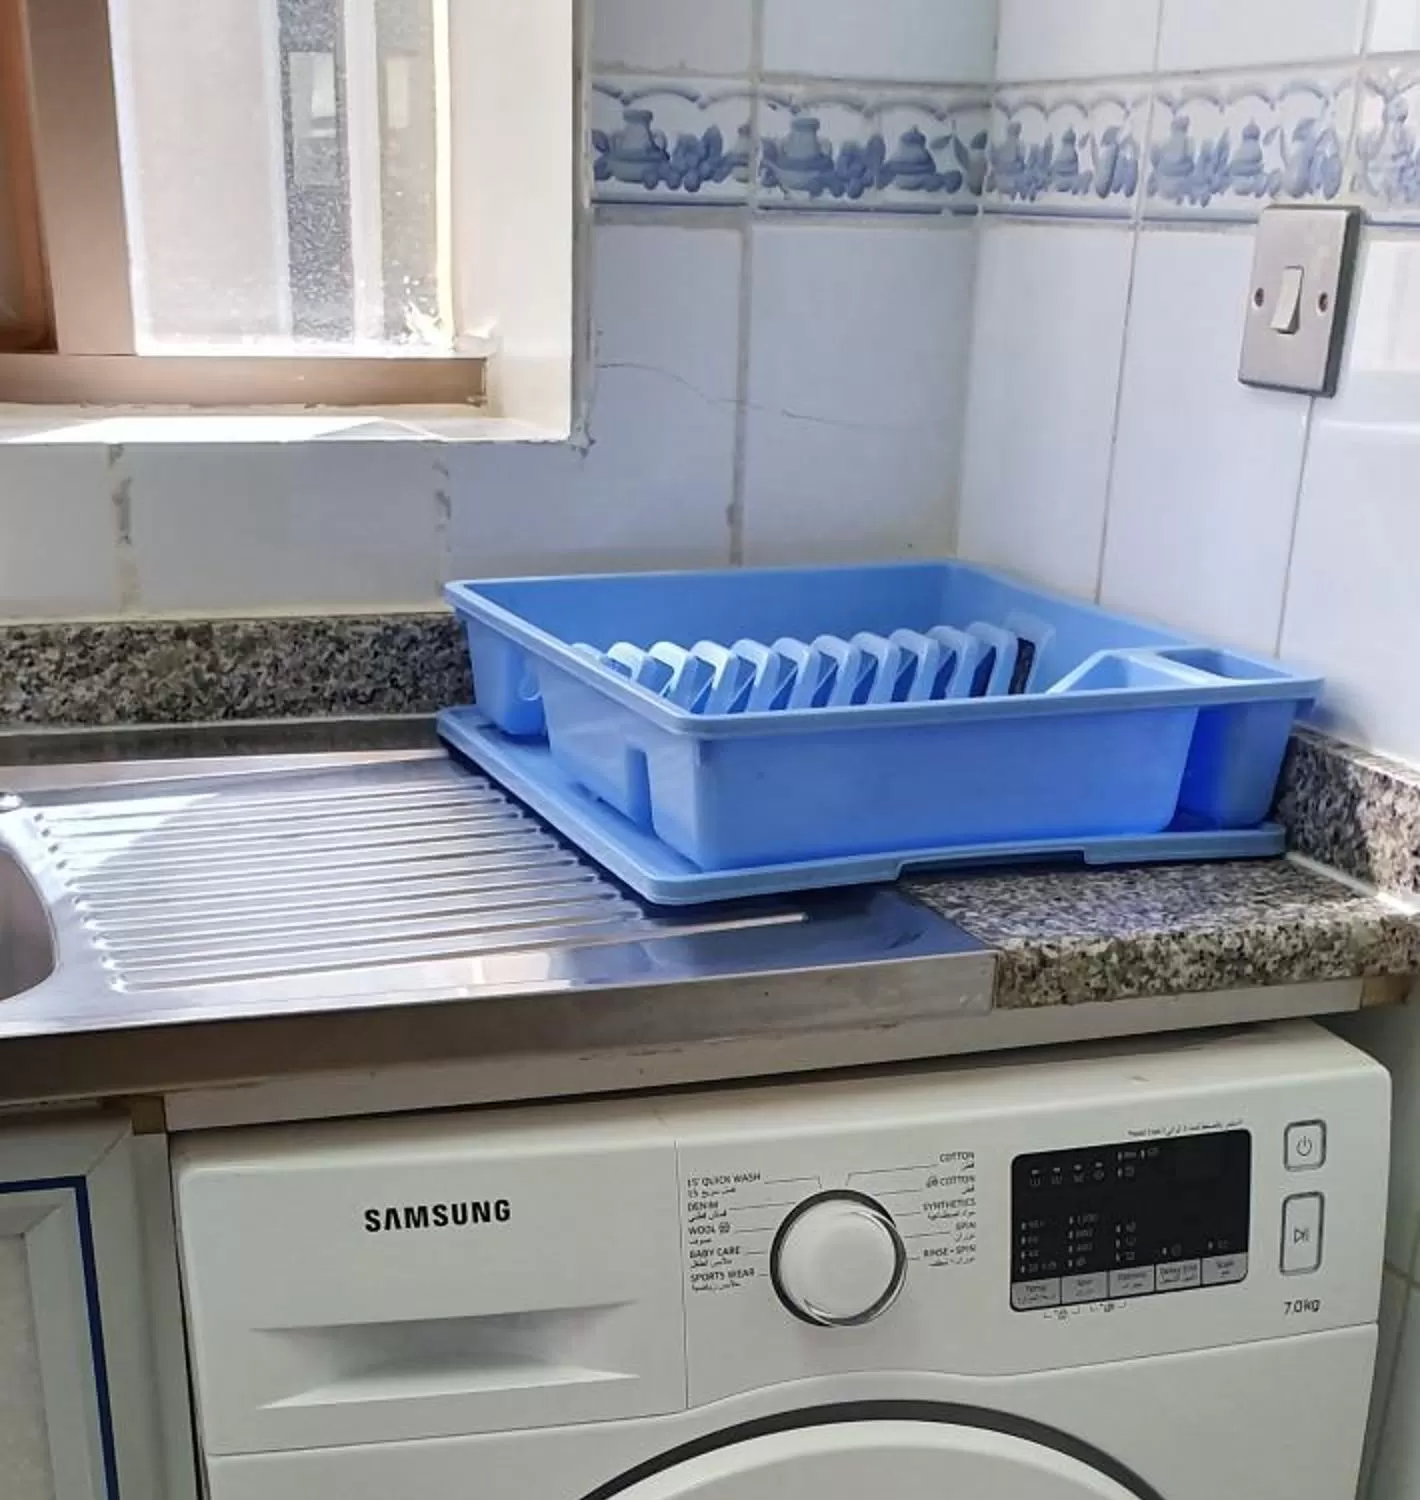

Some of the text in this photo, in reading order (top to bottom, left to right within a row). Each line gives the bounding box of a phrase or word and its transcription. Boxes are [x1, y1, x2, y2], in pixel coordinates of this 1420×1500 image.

[939, 1151, 975, 1163] COTTON
[702, 1175, 731, 1187] QUICK
[733, 1172, 760, 1183] WASH
[939, 1175, 976, 1186] COTTON
[687, 1201, 719, 1211] DENIM
[364, 1199, 511, 1233] SAMSUNG
[687, 1225, 716, 1235] WOOL
[689, 1245, 741, 1259] BABY CARE
[690, 1267, 755, 1282] SPORTS WEAR
